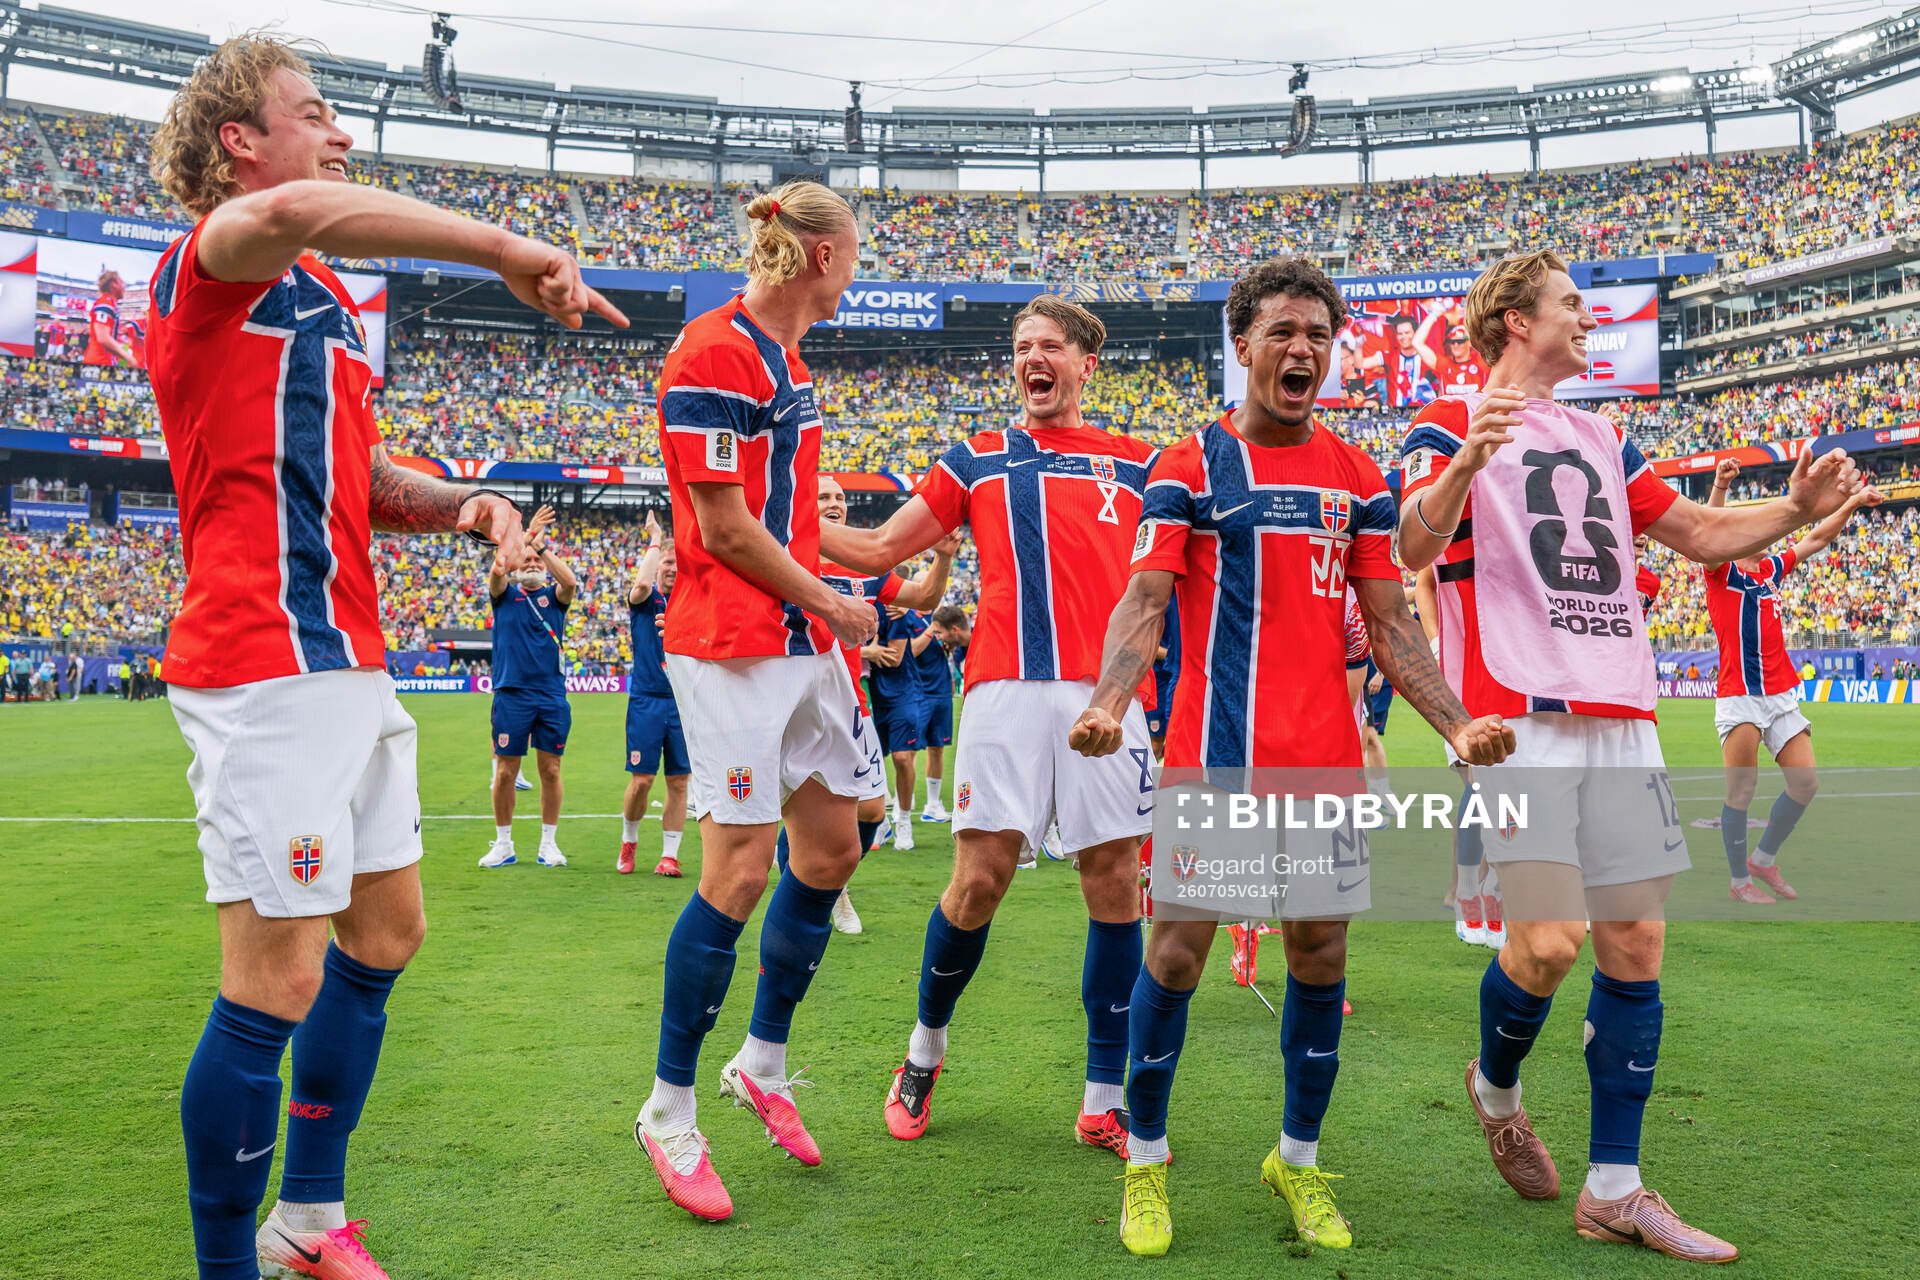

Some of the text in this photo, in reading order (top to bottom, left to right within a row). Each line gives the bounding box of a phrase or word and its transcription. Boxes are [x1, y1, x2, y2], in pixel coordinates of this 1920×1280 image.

[102, 221, 184, 243] #FIFAWorld
[1751, 241, 1884, 281] NEW YORK NEW JERSEY
[1341, 277, 1473, 298] FIFA WORLD CUP
[843, 290, 937, 309] YORK
[826, 311, 937, 328] JERSEY
[1096, 481, 1119, 524] 8
[1309, 535, 1351, 598] 22
[1560, 562, 1600, 582] FIFA
[1598, 602, 1628, 616] CUP
[1549, 608, 1632, 638] 2026
[1840, 680, 1879, 703] VISA
